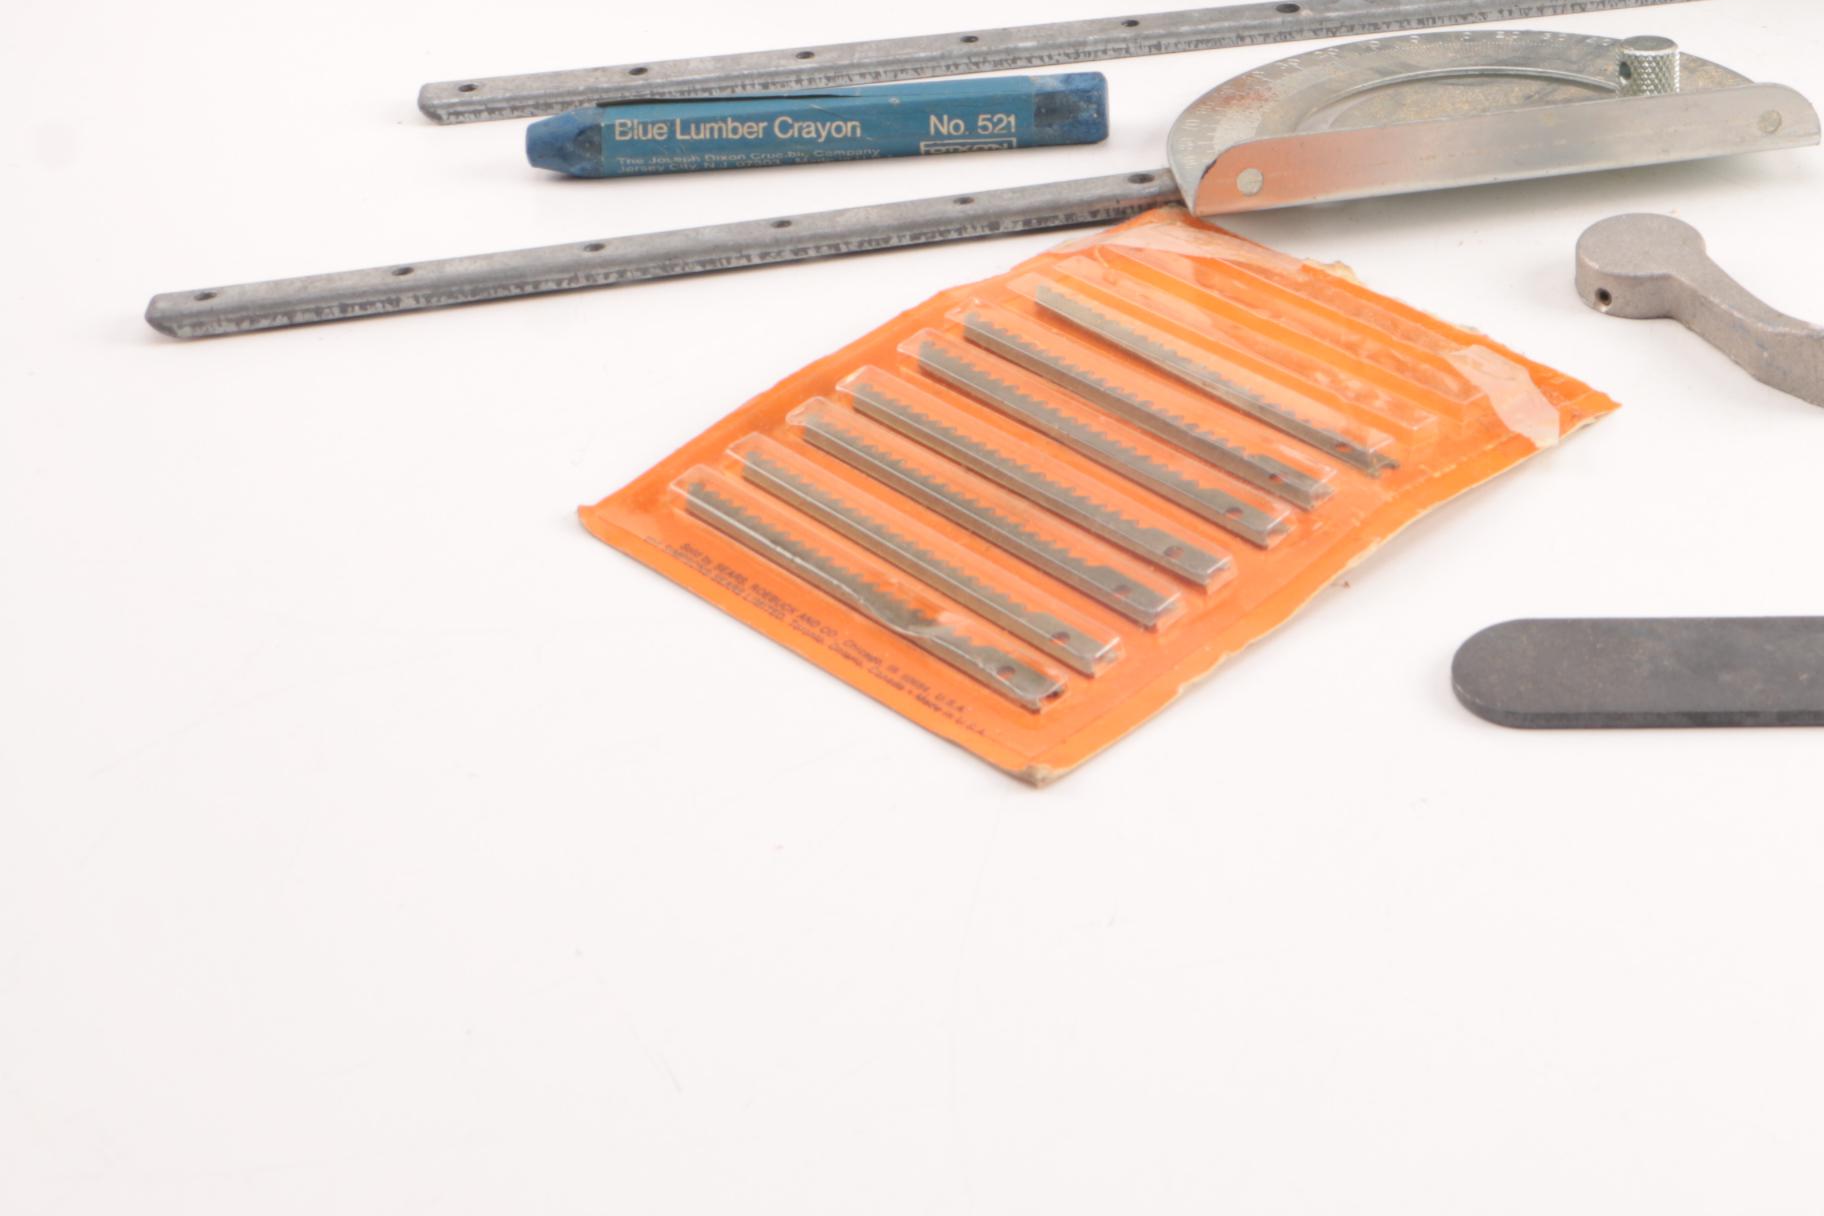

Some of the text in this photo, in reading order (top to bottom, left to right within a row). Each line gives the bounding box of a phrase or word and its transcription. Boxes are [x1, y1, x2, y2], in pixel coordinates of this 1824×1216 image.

[614, 115, 861, 142] Blue Lumber Crayon
[977, 112, 1016, 135] 521
[617, 156, 645, 166] The
[704, 152, 746, 164] Dixon
